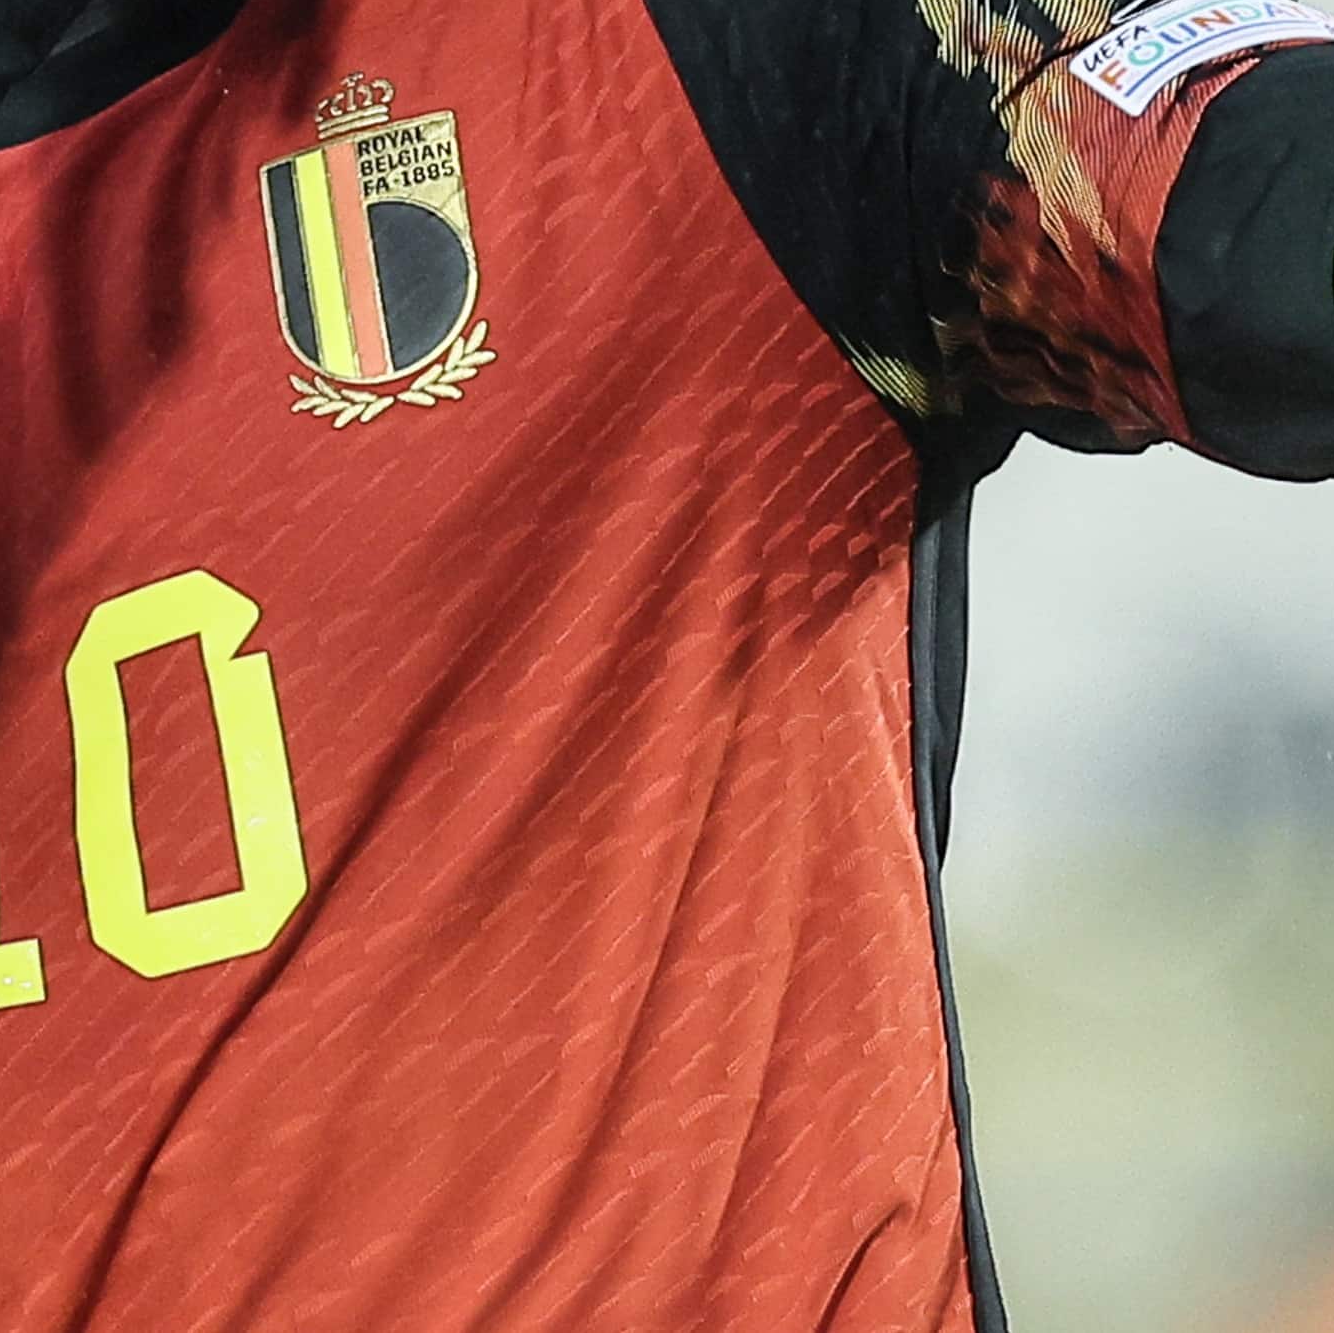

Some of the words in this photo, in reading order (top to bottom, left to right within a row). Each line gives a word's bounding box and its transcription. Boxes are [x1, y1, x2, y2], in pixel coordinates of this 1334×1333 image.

[1083, 24, 1149, 73] UEFA
[357, 125, 426, 157] ROYAL
[360, 140, 452, 177] BELGIAN
